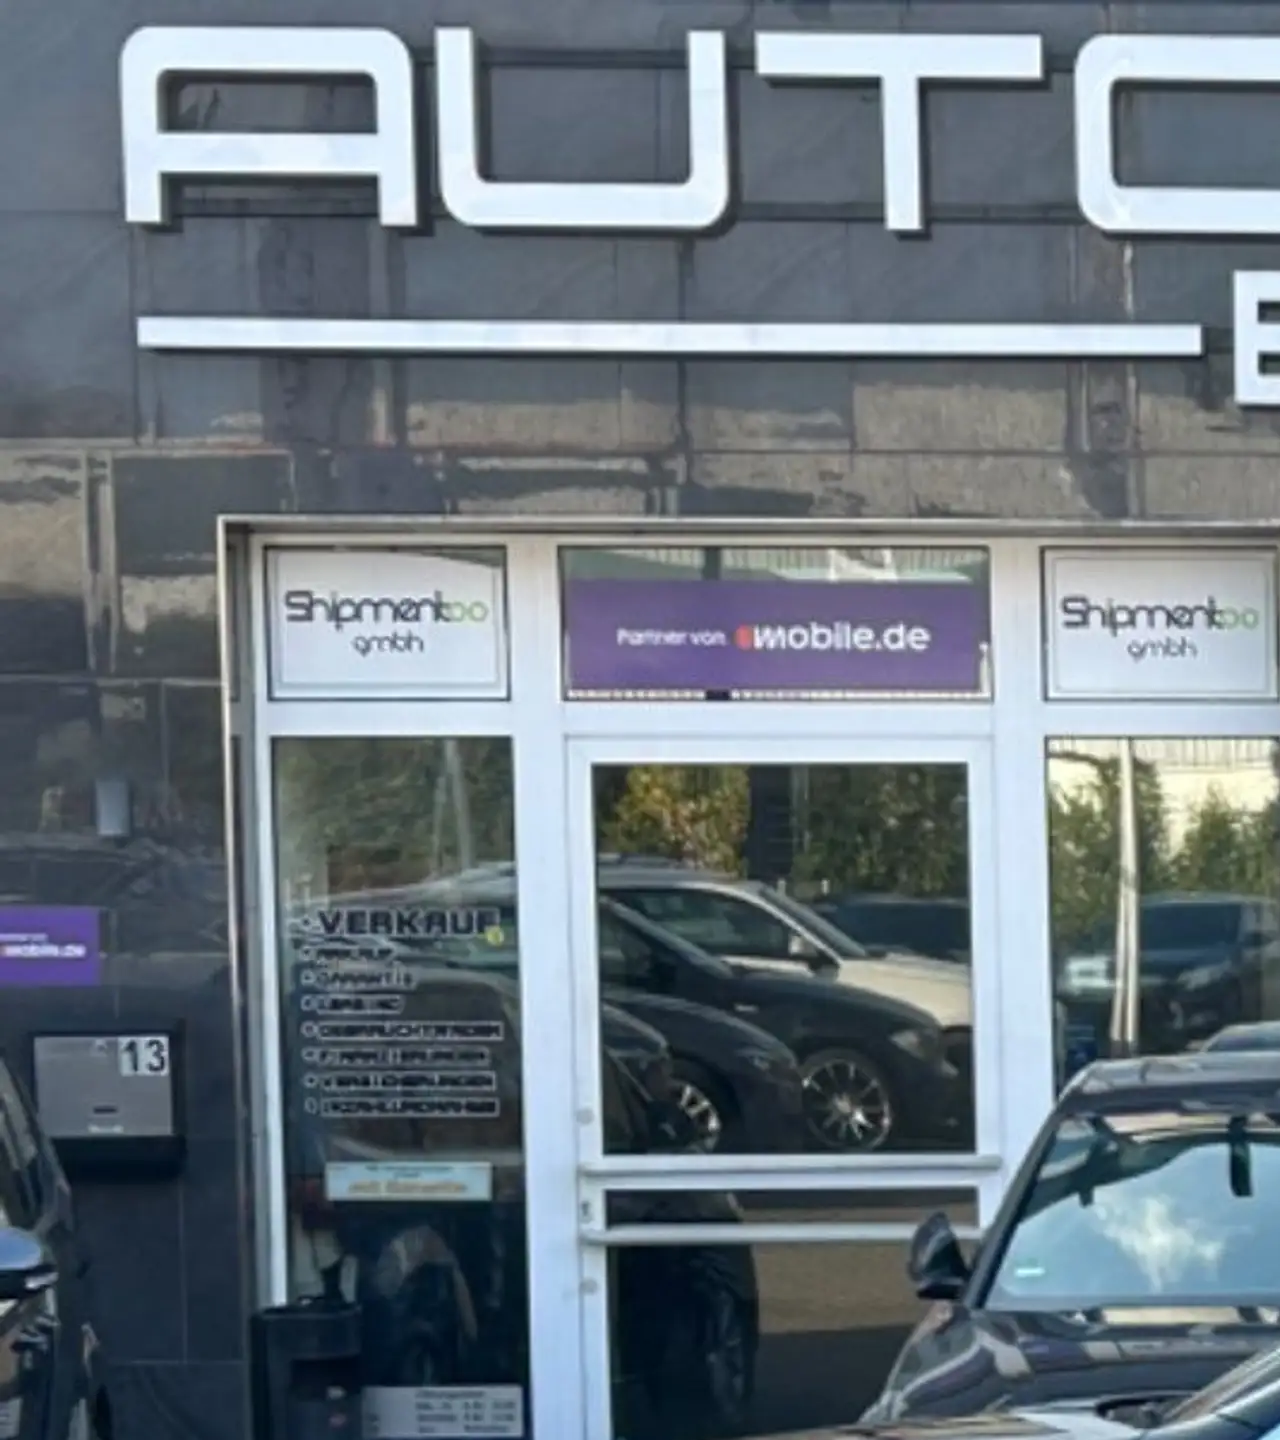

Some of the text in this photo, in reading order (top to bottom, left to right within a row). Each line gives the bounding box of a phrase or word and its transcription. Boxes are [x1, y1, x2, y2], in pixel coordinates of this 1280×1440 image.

[352, 630, 425, 657] gmbh
[616, 620, 931, 651] Partner von mobile.de
[122, 1038, 165, 1073] 13
